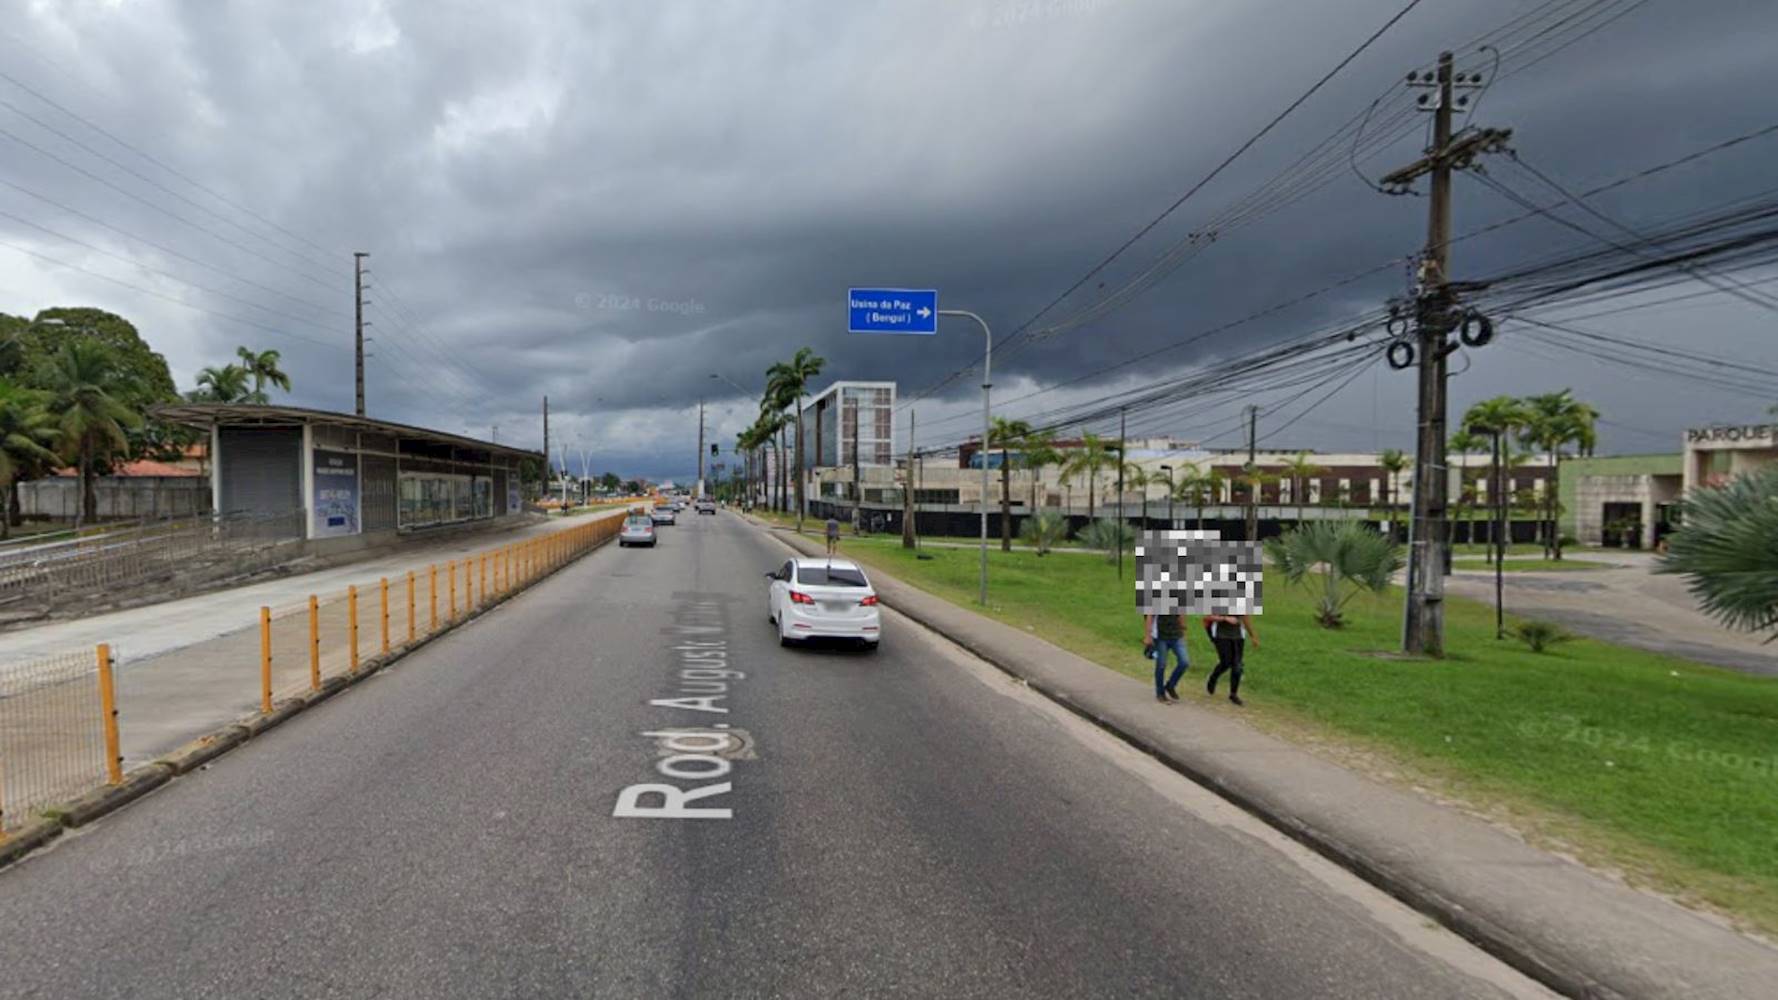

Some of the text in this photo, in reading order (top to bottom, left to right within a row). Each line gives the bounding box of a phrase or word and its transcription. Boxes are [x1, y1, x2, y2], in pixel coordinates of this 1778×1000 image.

[851, 299, 911, 310] Usina da Paz
[1687, 424, 1769, 442] PARQUE
